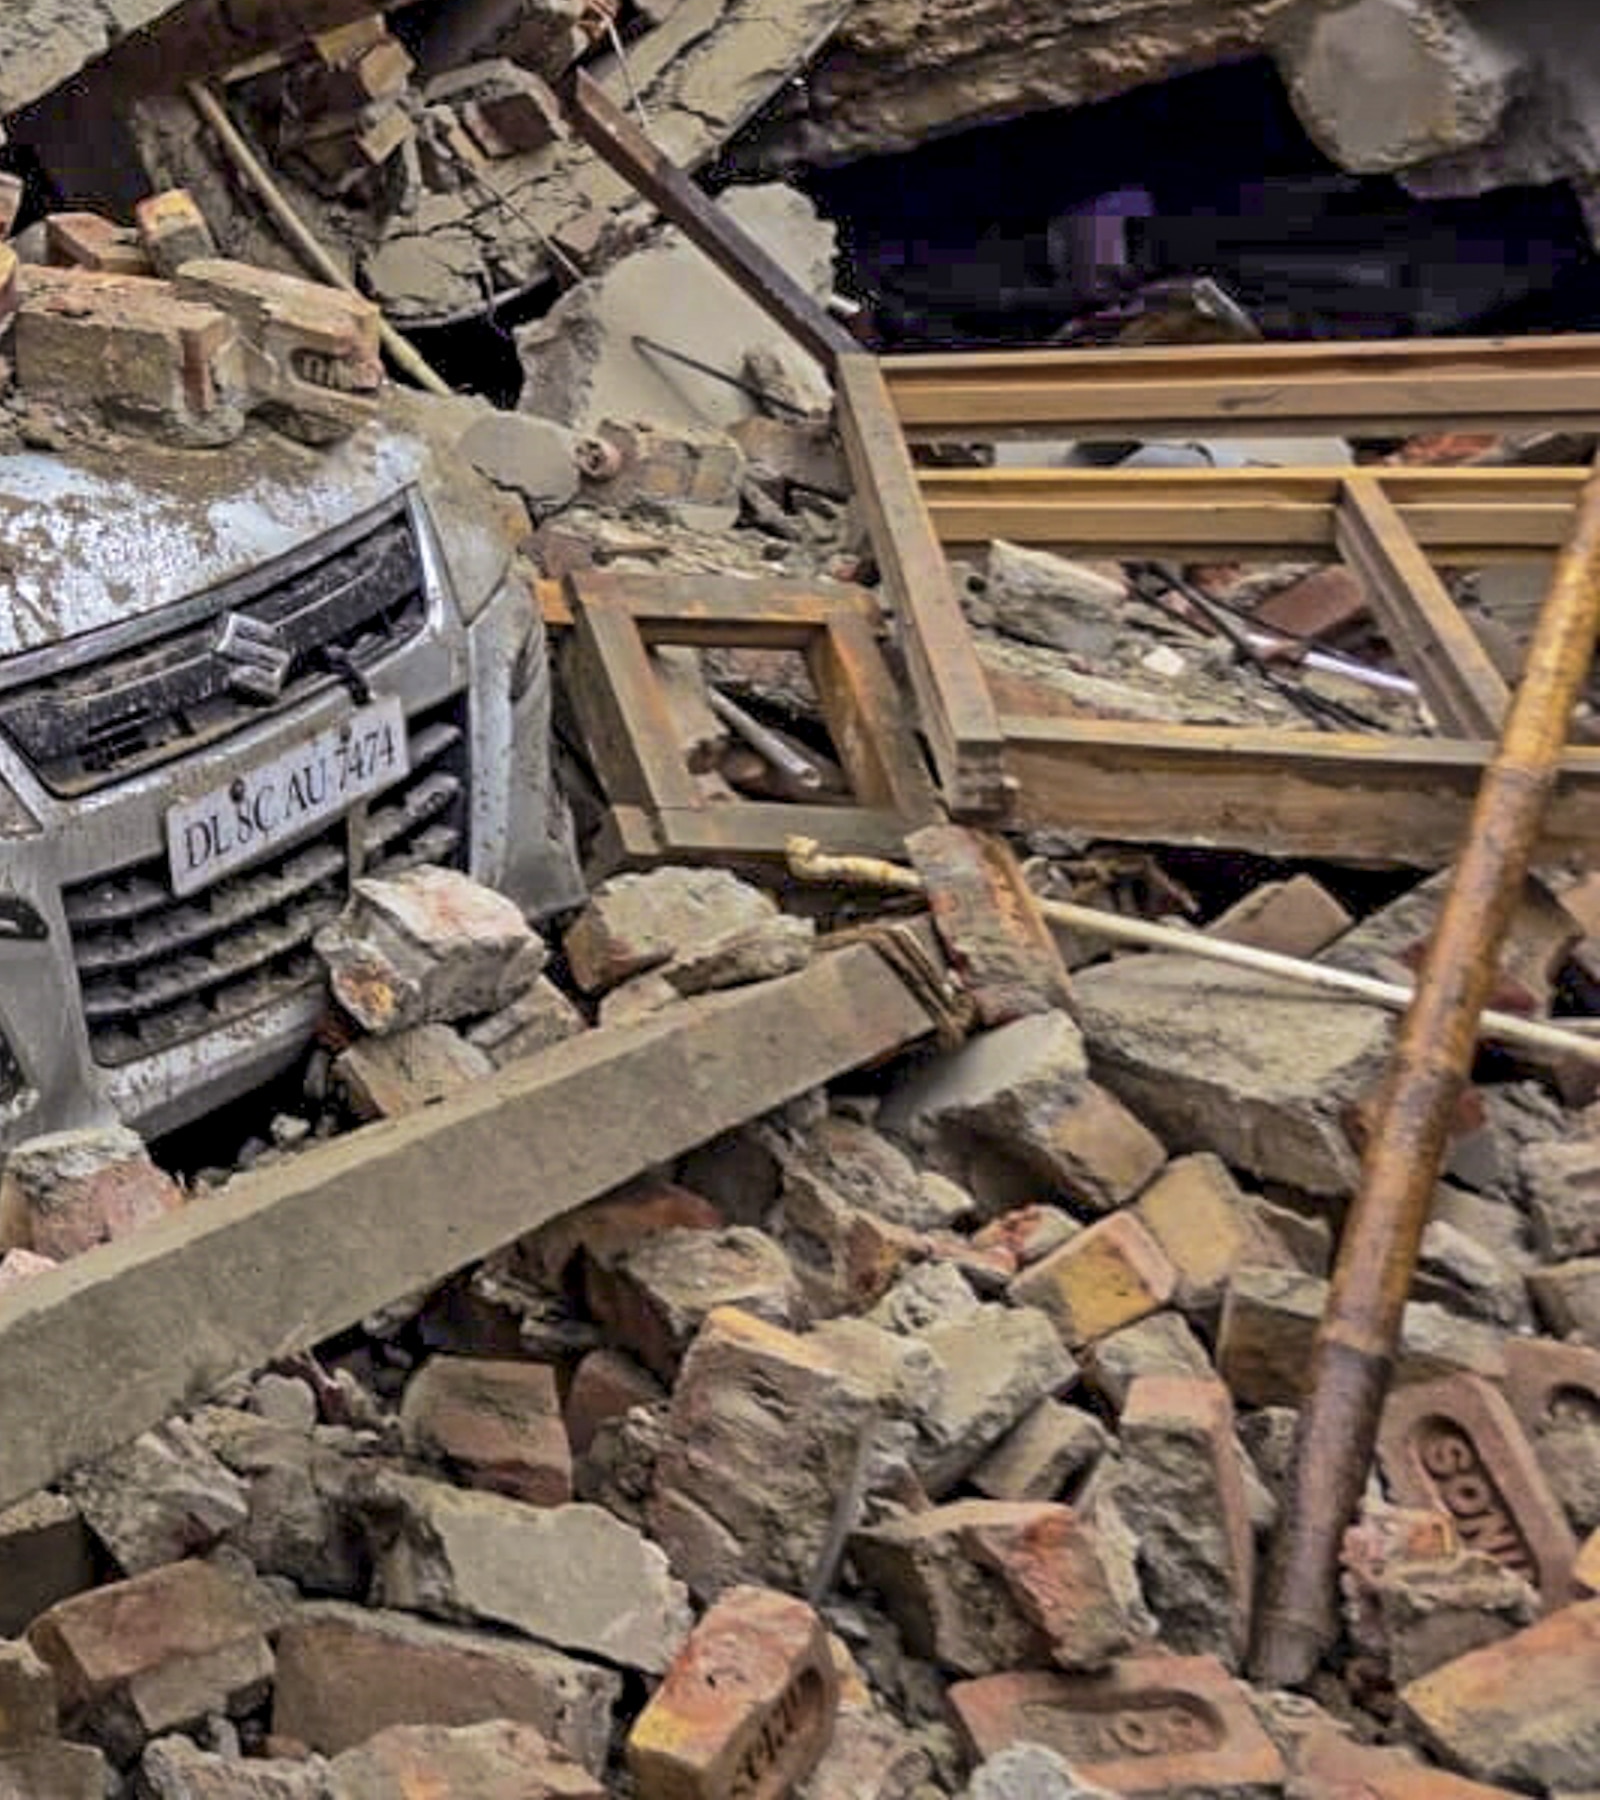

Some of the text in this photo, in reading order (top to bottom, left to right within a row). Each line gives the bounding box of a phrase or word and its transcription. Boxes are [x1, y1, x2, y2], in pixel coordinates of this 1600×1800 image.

[184, 720, 397, 871] DL 8C AU 7474
